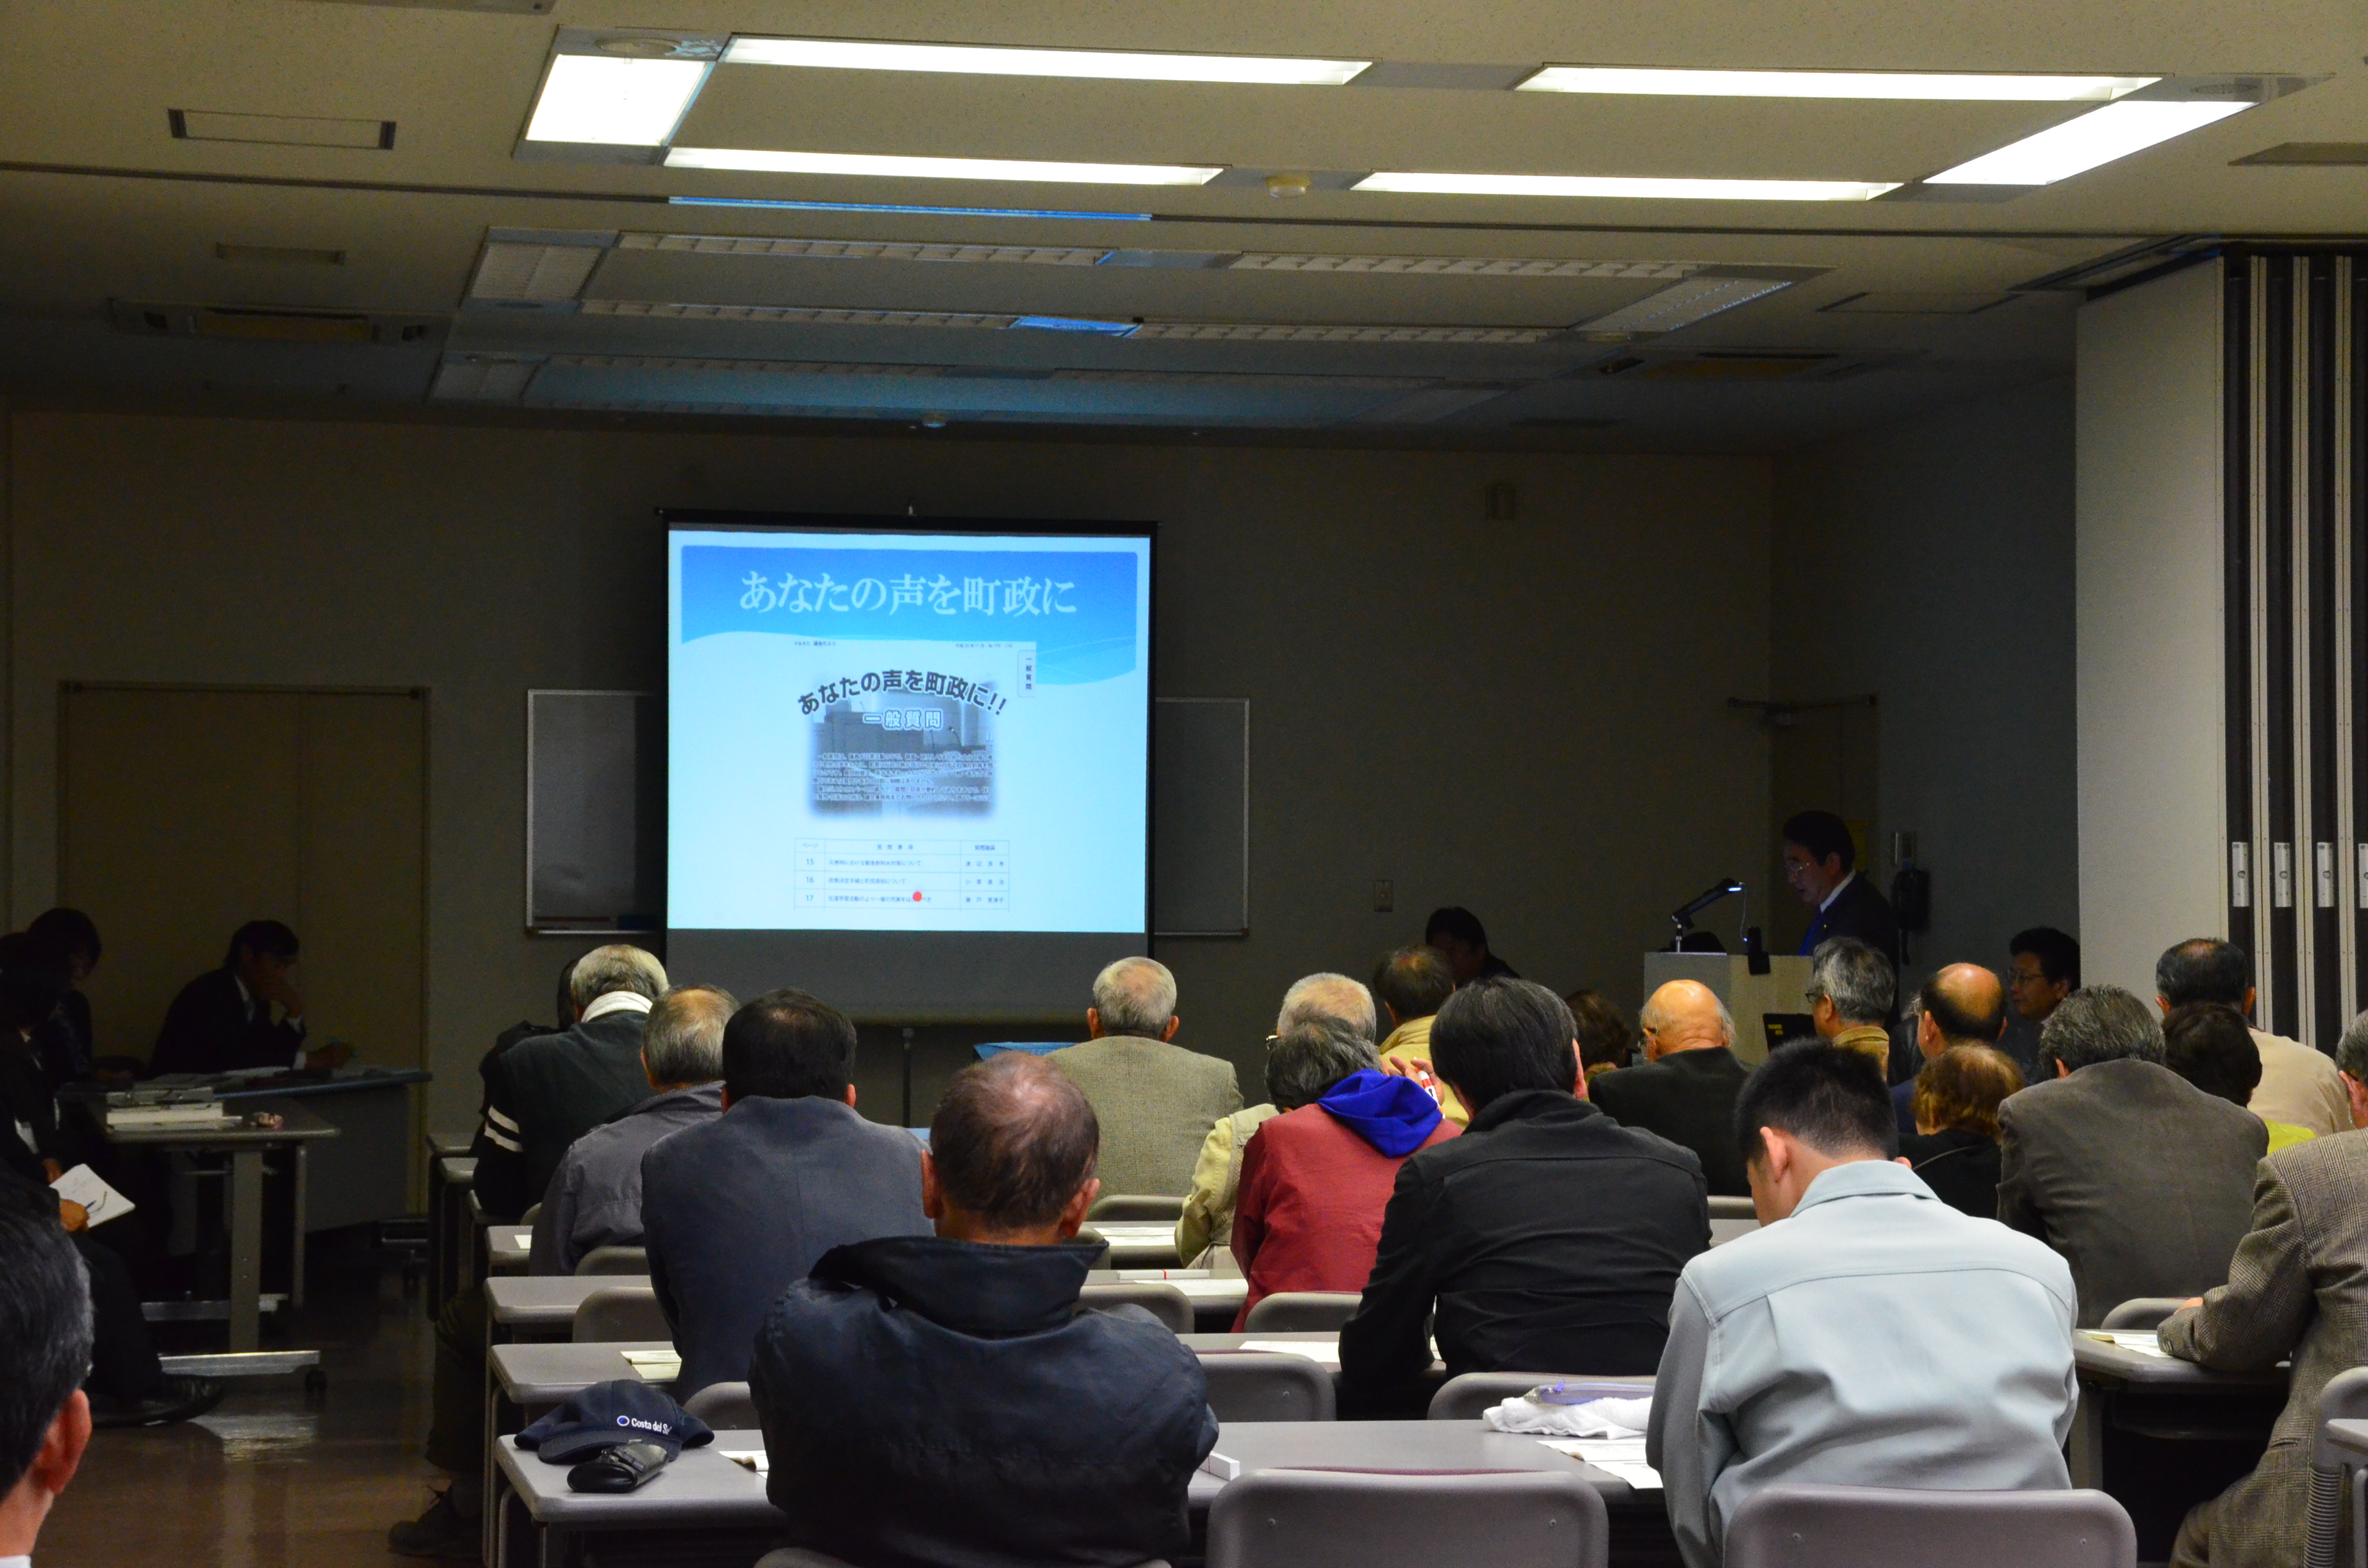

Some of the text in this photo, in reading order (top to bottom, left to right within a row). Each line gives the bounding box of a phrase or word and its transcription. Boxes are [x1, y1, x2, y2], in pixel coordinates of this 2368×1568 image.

[739, 569, 1077, 616] あなたの声を町政に
[798, 669, 1007, 715] あなたの声を町政に!!
[863, 709, 943, 730] 一般質問
[631, 1417, 652, 1430] Costa
[652, 1421, 662, 1433] del
